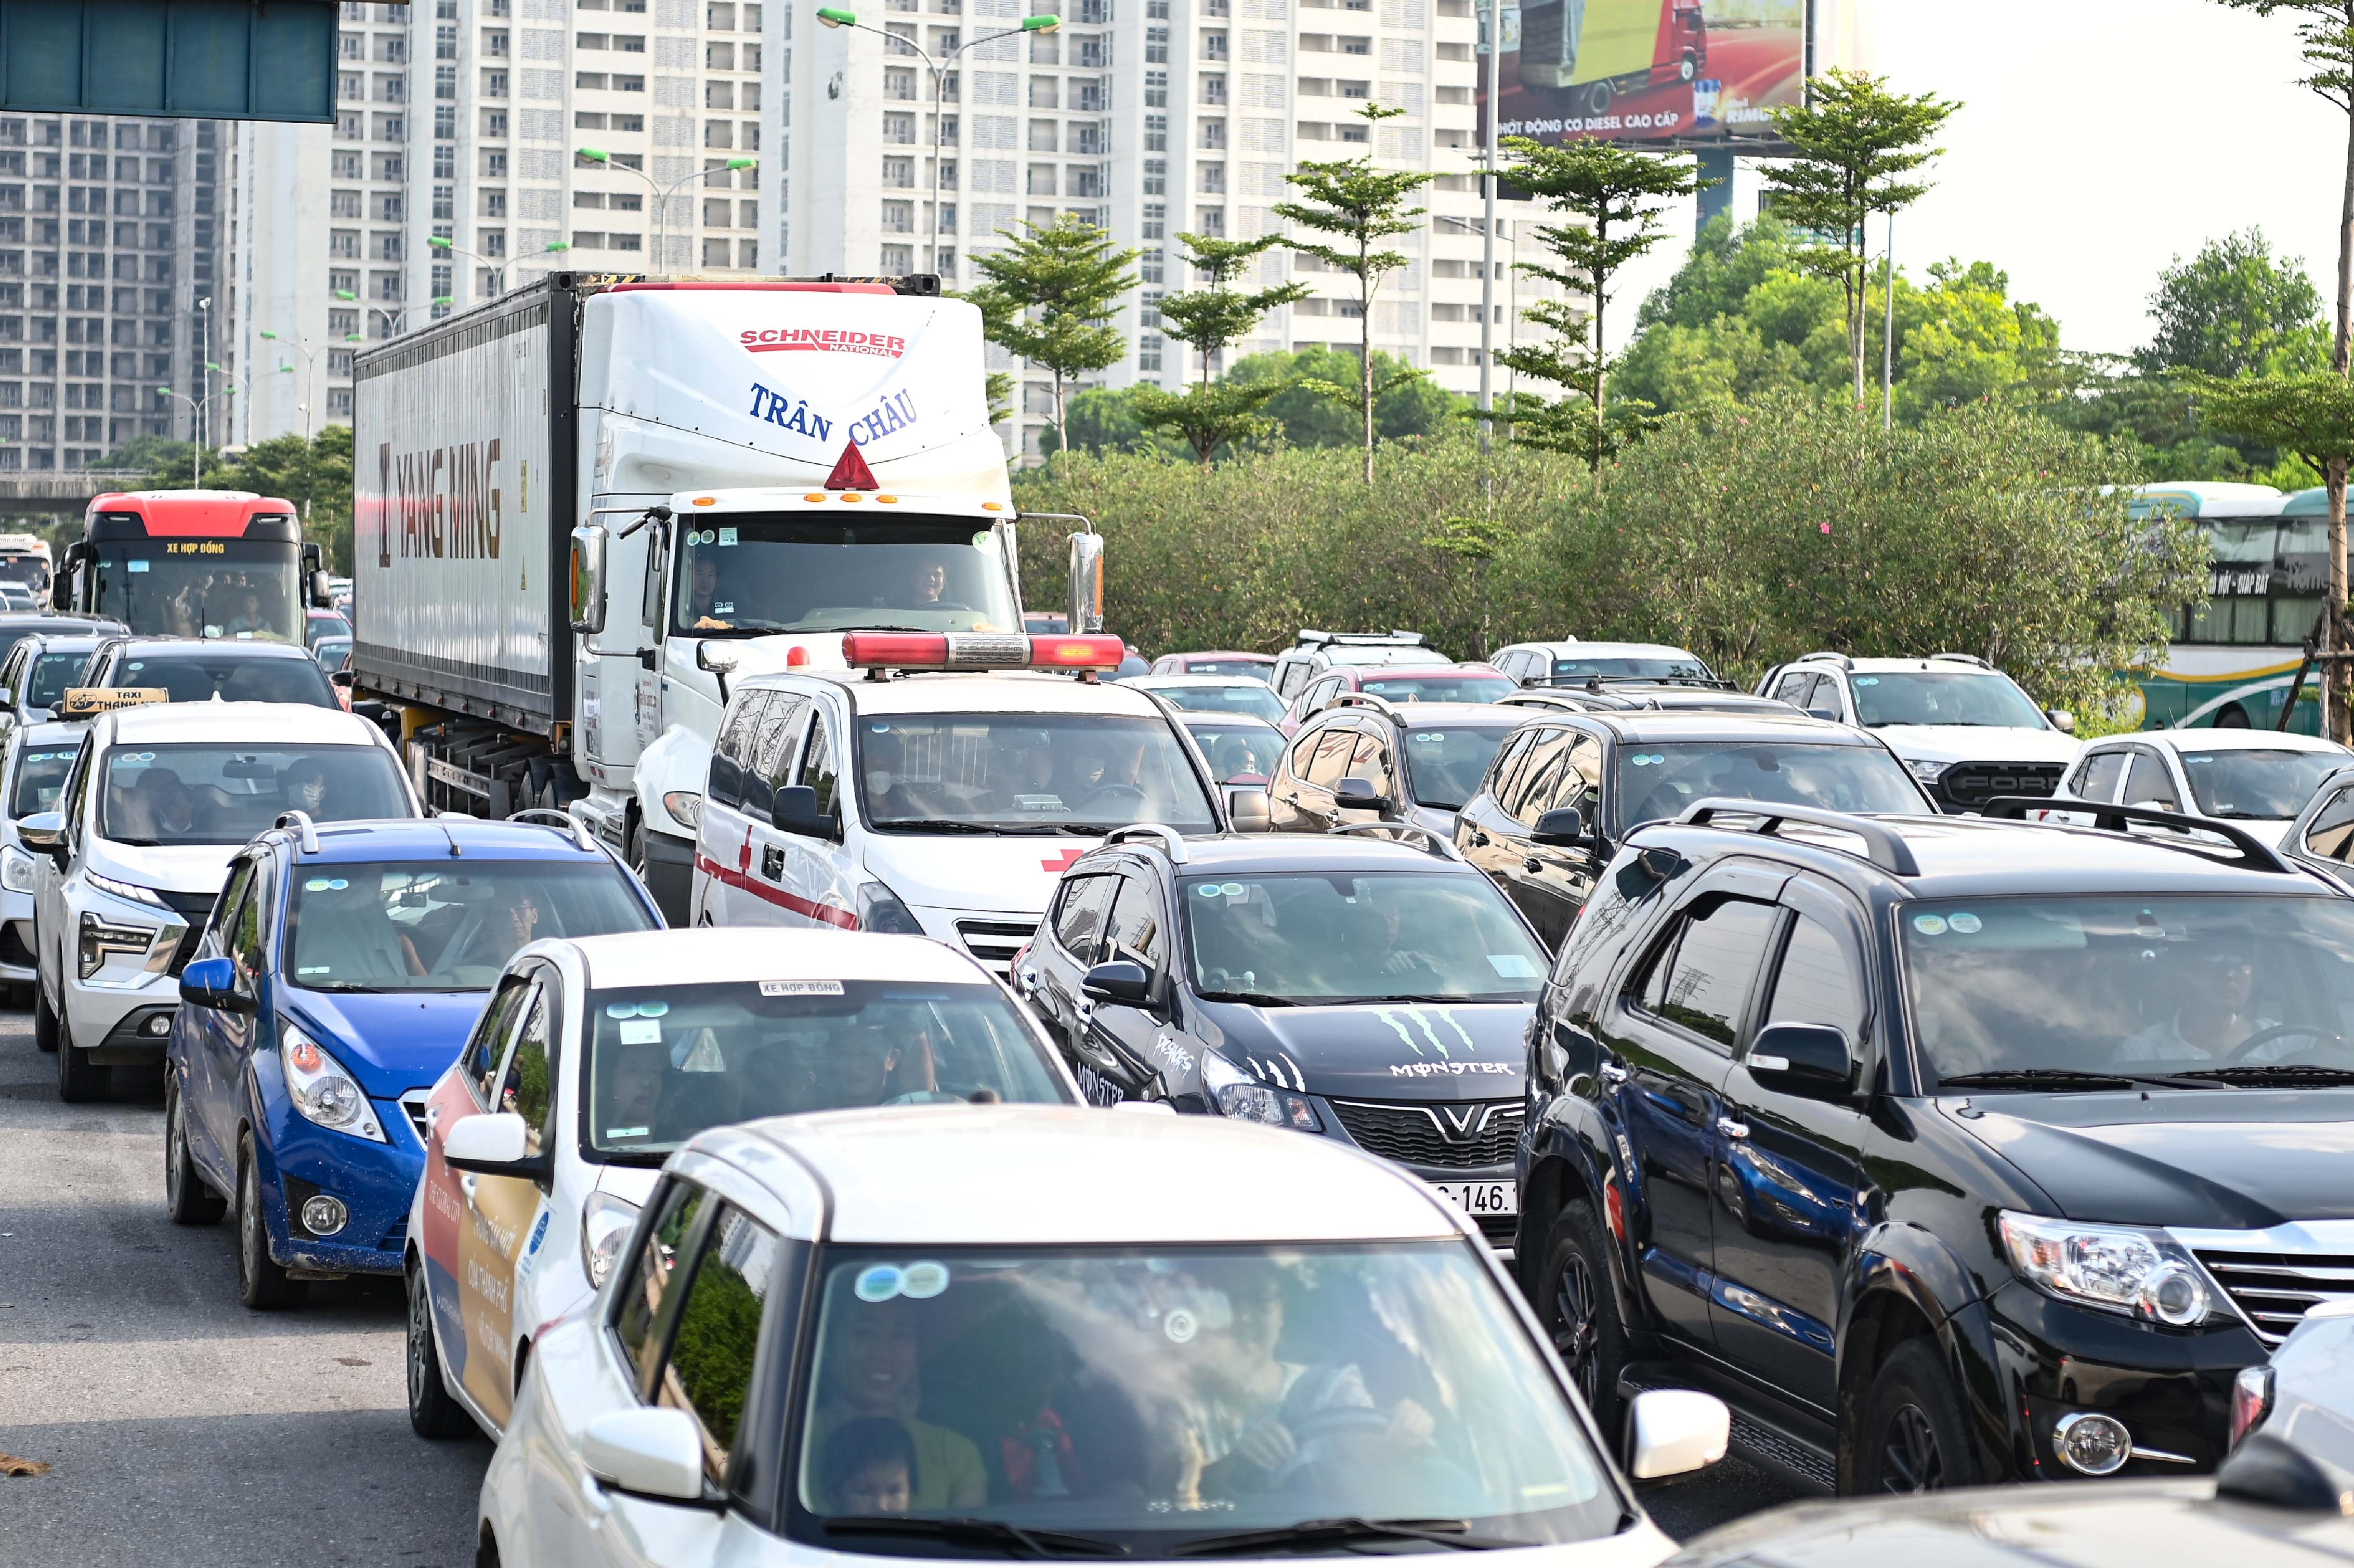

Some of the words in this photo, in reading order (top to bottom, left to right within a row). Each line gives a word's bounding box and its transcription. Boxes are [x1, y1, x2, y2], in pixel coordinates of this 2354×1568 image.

[1585, 115, 1623, 130] DIESEL
[1625, 113, 1652, 128] CAO
[1654, 110, 1679, 127] CẤP
[740, 330, 905, 350] SCHNEIDER
[829, 344, 897, 358] NATIONAL
[750, 383, 833, 442] TRÂN
[848, 388, 917, 446] CHÂU
[396, 448, 443, 558] YANG
[449, 438, 500, 559] MING
[167, 543, 178, 554] XE
[180, 542, 198, 556] HỢP
[1437, 1185, 1516, 1212] -146.
[451, 1200, 461, 1225] CITY
